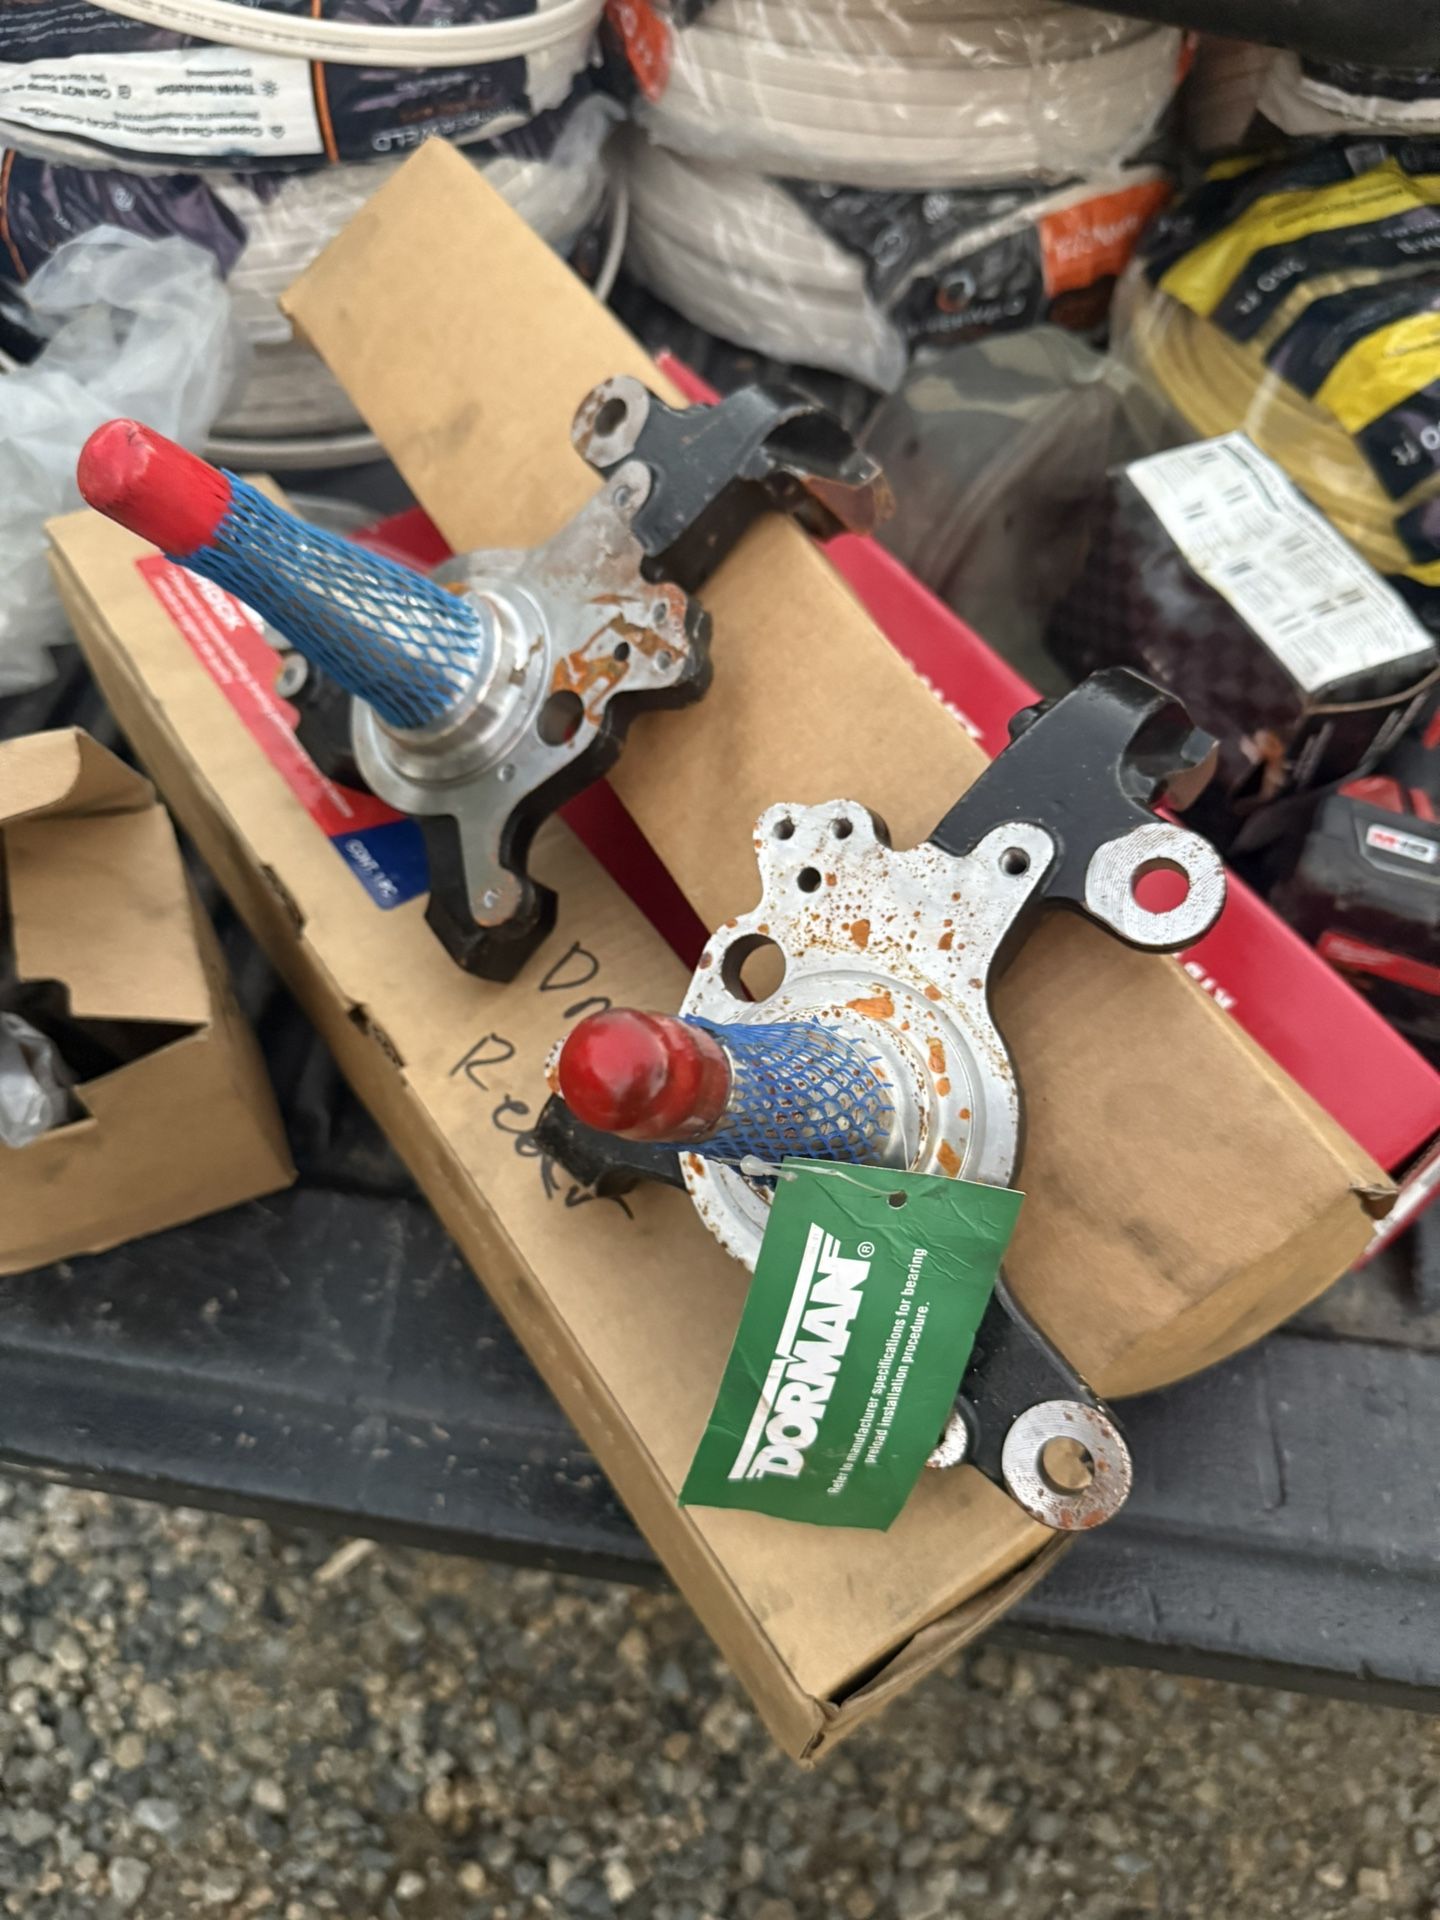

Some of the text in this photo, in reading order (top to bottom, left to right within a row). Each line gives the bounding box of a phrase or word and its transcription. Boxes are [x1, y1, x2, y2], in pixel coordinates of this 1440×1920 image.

[900, 1247, 928, 1297] bearing
[895, 1296, 911, 1318] for
[730, 1223, 872, 1480] DORMAN
[864, 1301, 931, 1466] preload installation procedure.
[871, 1317, 907, 1396] specifications
[847, 1396, 880, 1465] manufacturer
[826, 1466, 849, 1497] Refer
